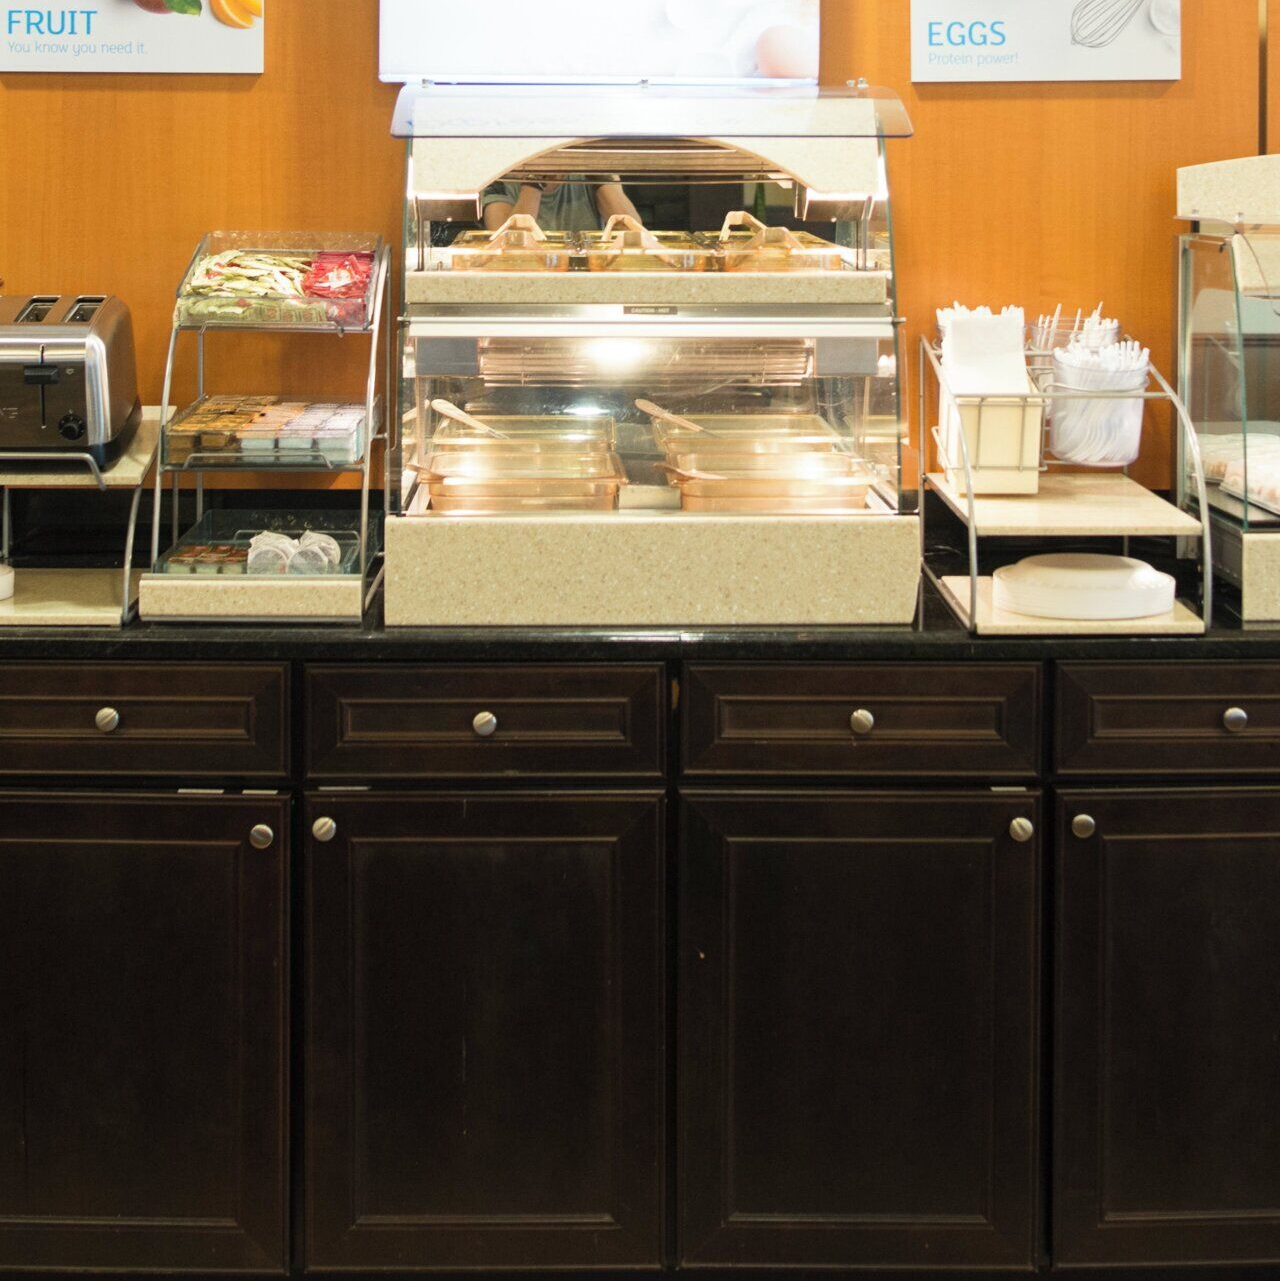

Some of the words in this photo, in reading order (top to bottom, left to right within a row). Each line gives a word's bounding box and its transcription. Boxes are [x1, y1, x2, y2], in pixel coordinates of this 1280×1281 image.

[7, 9, 97, 35] FRUIT
[928, 21, 1007, 47] EGGS
[8, 42, 30, 54] You
[35, 41, 68, 54] know
[73, 44, 97, 57] you
[101, 41, 132, 54] need
[136, 41, 148, 54] it.
[928, 52, 973, 65] Protein
[977, 52, 1019, 67] power!
